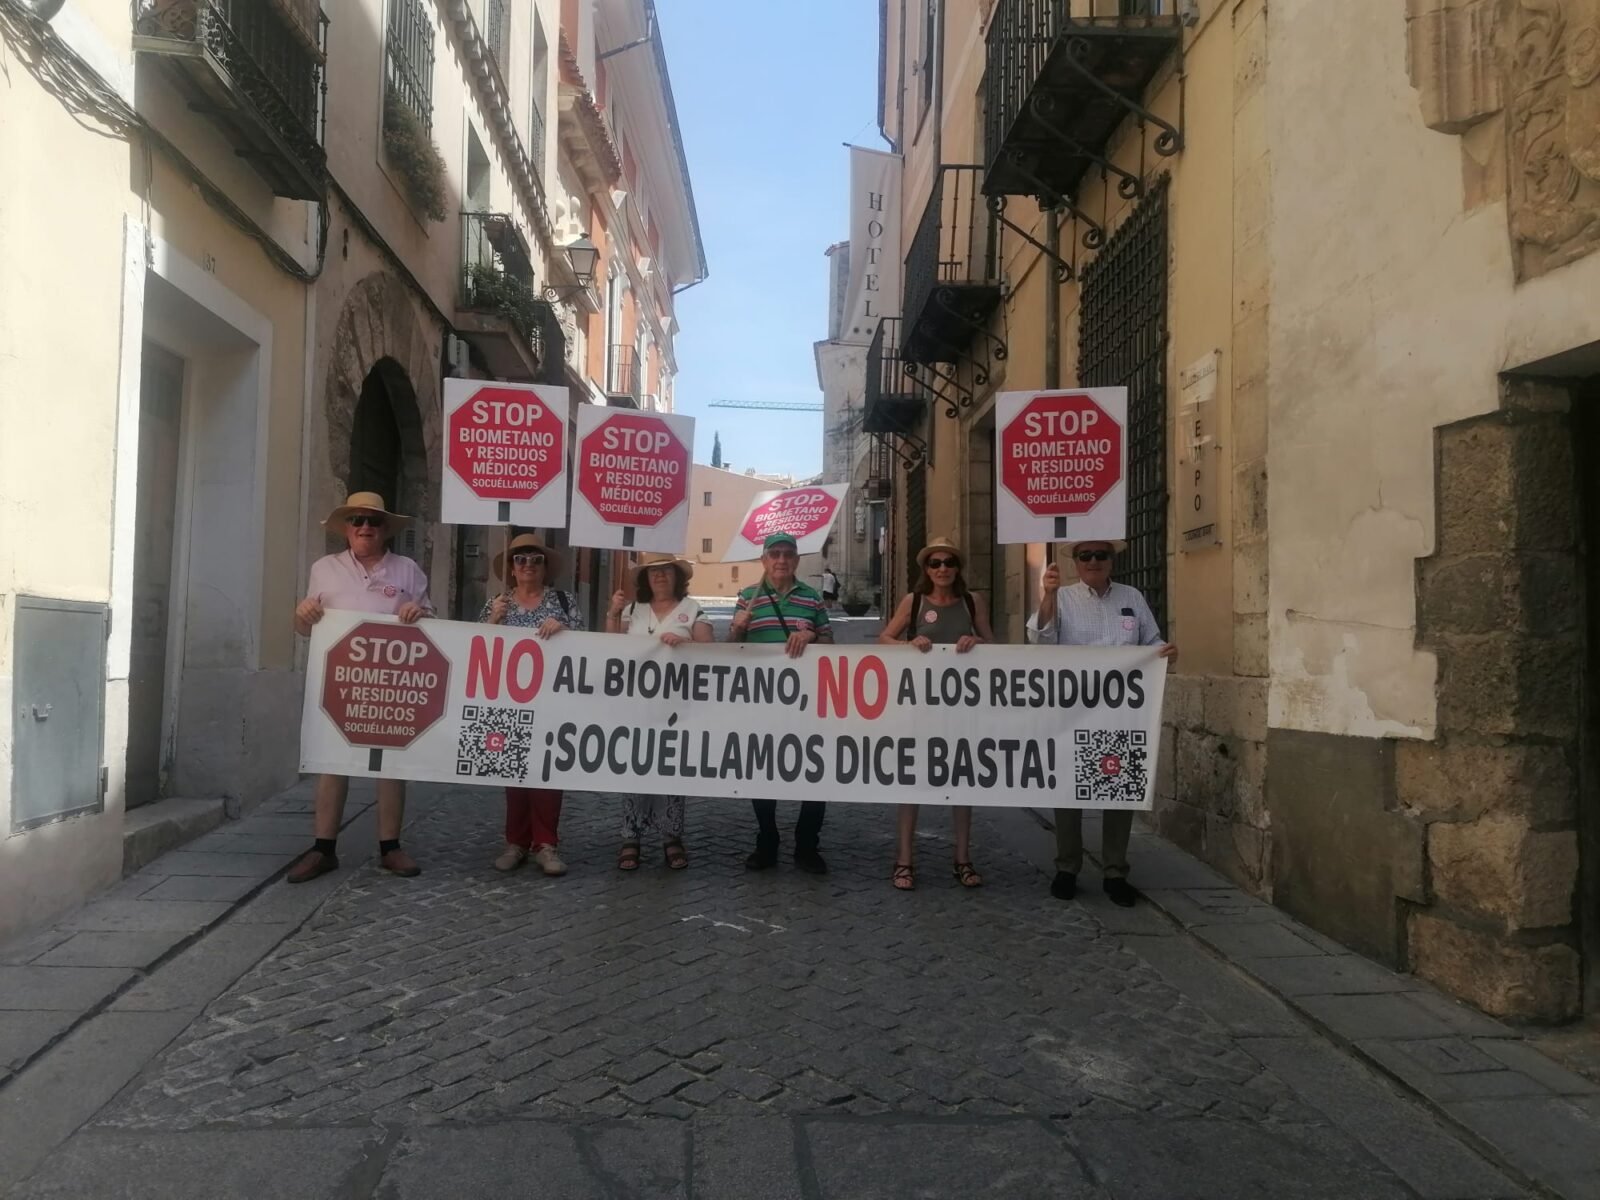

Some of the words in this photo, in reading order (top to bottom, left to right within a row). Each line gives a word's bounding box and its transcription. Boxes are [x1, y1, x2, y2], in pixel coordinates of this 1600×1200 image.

[864, 192, 883, 317] HOTEL
[472, 400, 543, 427] STOP
[1025, 410, 1098, 437] STOP
[459, 427, 554, 447] BIOMETANO
[602, 426, 670, 454] STOP
[465, 448, 473, 458] Y
[477, 446, 547, 462] RESIDUOS
[1013, 439, 1111, 458] BIOMETANO
[473, 460, 537, 477] MÉDICOS
[590, 452, 679, 475] BIOMETANO
[1019, 464, 1027, 474] Y
[1031, 458, 1104, 473] RESIDUOS
[472, 478, 539, 490] SOCUÉLLAMOS
[594, 472, 603, 483] Y
[606, 472, 672, 490] RESIDUOS
[1027, 474, 1094, 491] MÉDICOS
[601, 484, 662, 504] MÉDICOS
[769, 494, 824, 511] STOP
[1027, 492, 1096, 504] SOCUÉLLAMOS
[600, 503, 663, 517] SOCUÉLLAMOS
[754, 506, 828, 522] BIOMETANO
[765, 514, 820, 527] RESIDUOS
[348, 636, 428, 666] STOP
[335, 666, 437, 689] BIOMETANO
[465, 635, 544, 704] NO
[553, 655, 594, 695] AL
[604, 657, 809, 712] BIOMETANO,
[817, 654, 889, 720] NO
[897, 667, 917, 705] A
[925, 667, 981, 707] LOS
[990, 668, 1145, 709] RESIDUOS
[340, 688, 348, 699] Y
[352, 687, 428, 705] RESIDUOS
[346, 702, 415, 722] MÉDICOS
[344, 722, 415, 736] SOCUÉLLAMOS
[541, 712, 825, 784] ¡SOCUÉLLAMOS
[836, 735, 916, 786] DICE
[927, 737, 1057, 790] BASTA!
